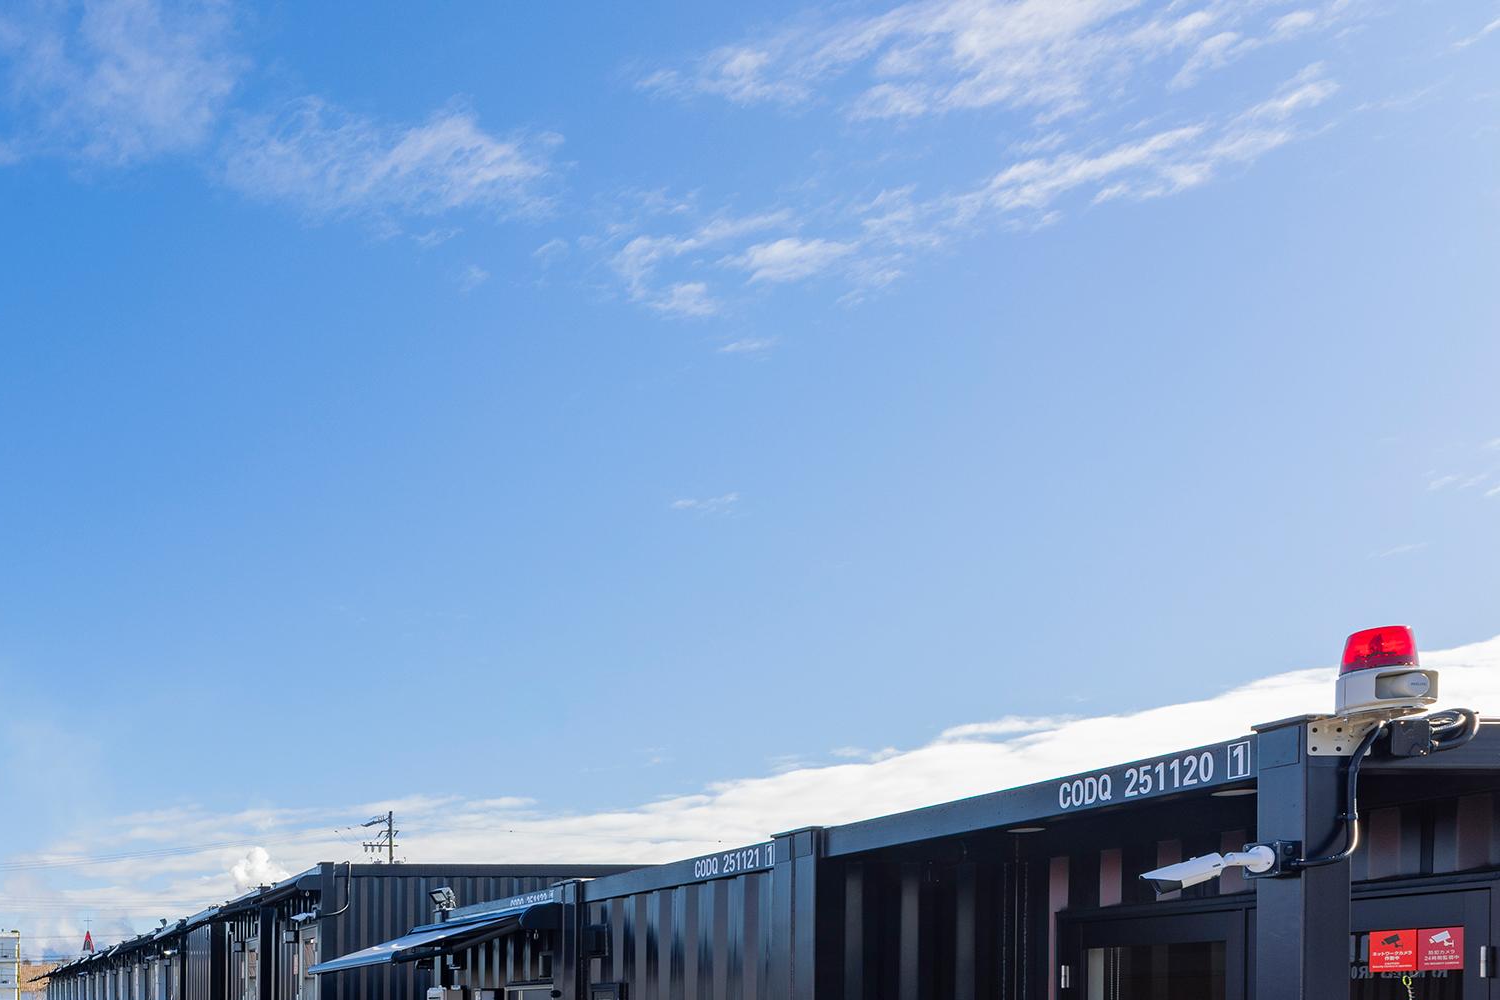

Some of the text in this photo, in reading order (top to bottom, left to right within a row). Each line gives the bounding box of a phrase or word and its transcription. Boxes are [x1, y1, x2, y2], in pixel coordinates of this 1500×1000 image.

[1059, 774, 1112, 808] CODQ
[1125, 751, 1214, 798] 251120
[694, 857, 719, 878] CODQ
[723, 847, 760, 873] 251121
